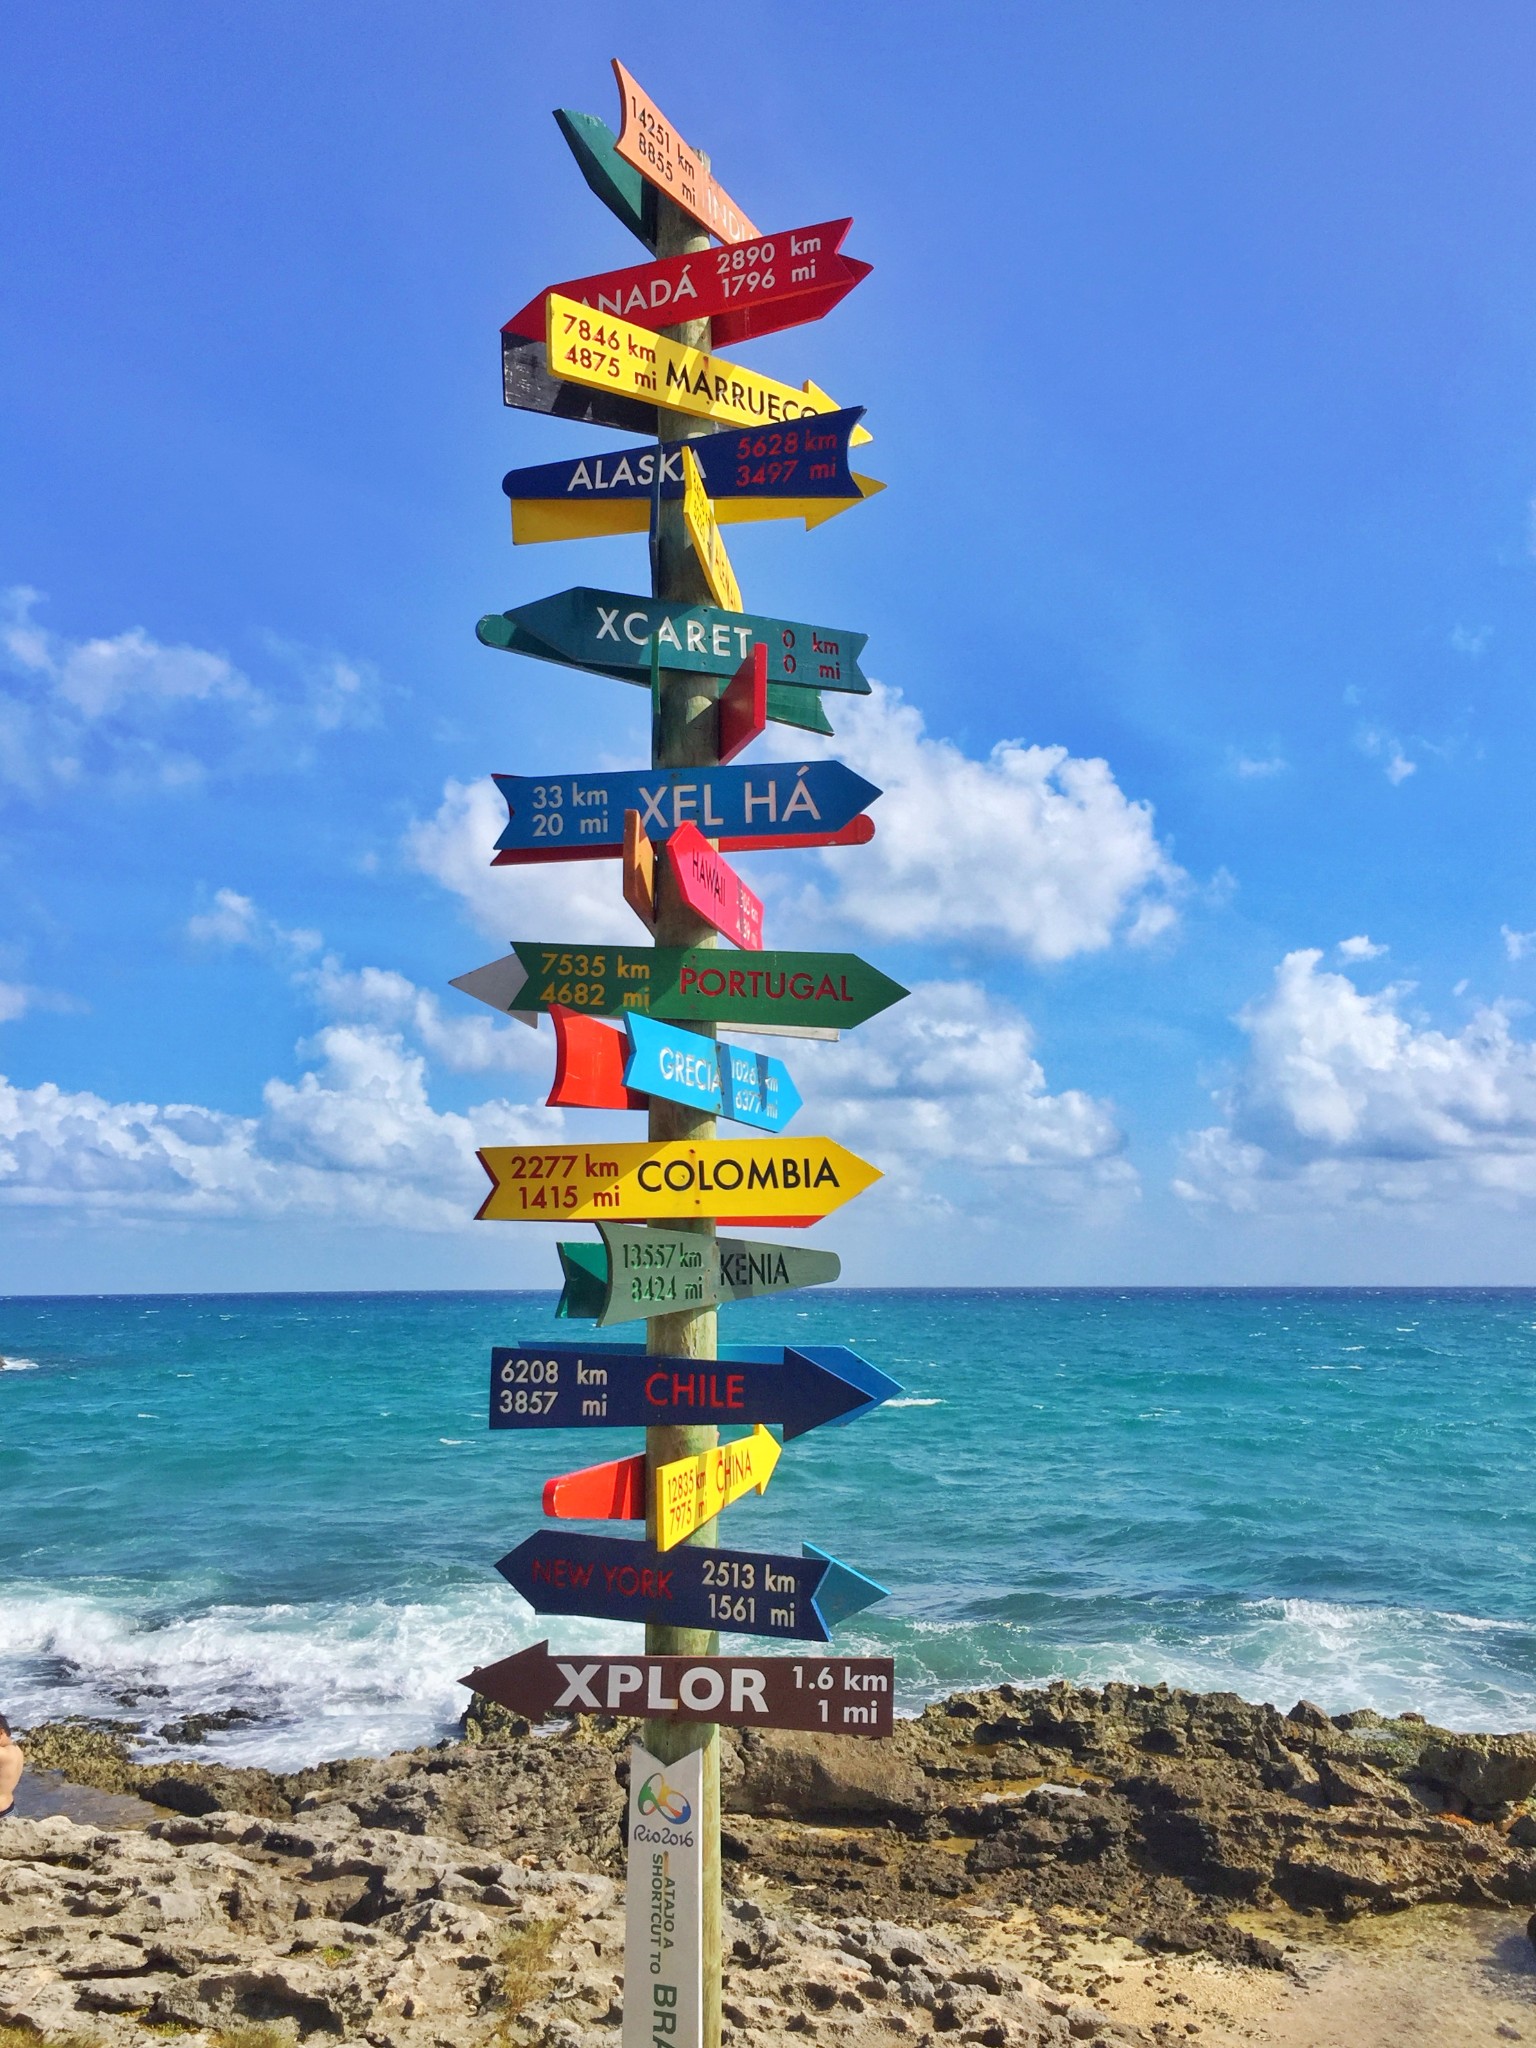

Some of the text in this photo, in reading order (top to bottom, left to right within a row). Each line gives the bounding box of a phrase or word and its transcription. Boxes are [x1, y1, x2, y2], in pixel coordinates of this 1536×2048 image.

[632, 96, 695, 180] 14251 km
[638, 132, 696, 207] 8855 mi
[707, 188, 753, 240] INDI
[717, 236, 821, 275] 2890 km
[721, 259, 816, 298] 1796 mi
[563, 313, 657, 365] 7846 km
[564, 344, 657, 391] 4875 mi
[736, 428, 837, 460] 5628 km
[567, 449, 707, 492] ALASKA
[736, 456, 836, 488] 3497 mi
[596, 607, 753, 659] XCARET
[782, 629, 839, 655] 0 km
[783, 654, 841, 680] 0 mi
[532, 782, 608, 809] 33 km
[638, 766, 821, 828] XEL HÁ
[532, 811, 608, 837] 20 mi
[692, 848, 726, 907] HAWAII
[541, 953, 650, 979] 7535 km
[539, 982, 650, 1010] 4682 mi
[680, 967, 854, 1002] PORTUGAL
[659, 1047, 722, 1094] GRECIA
[735, 1089, 763, 1114] 6377
[511, 1153, 619, 1179] 2277 km
[637, 1157, 840, 1192] COLOMBIA
[518, 1184, 620, 1209] 1415 mi
[622, 1242, 702, 1269] 13557 km
[720, 1252, 790, 1286] KENIA
[631, 1275, 703, 1302] 8424 mi
[501, 1360, 608, 1385] 6208 km
[644, 1371, 745, 1409] CHILE
[499, 1389, 607, 1416] 3857 mi
[667, 1468, 694, 1505] 12835
[716, 1448, 752, 1494] CHINA
[670, 1500, 692, 1535] 7975
[531, 1558, 674, 1600] NEW YORK
[702, 1560, 796, 1594] 2513 km
[708, 1593, 795, 1628] 1561 mi
[553, 1663, 770, 1713] XPLOR
[792, 1665, 888, 1692] 1.6 km
[818, 1699, 878, 1723] 1 mi
[649, 1853, 664, 1974] SHORTCUT TO
[663, 1876, 676, 1949] ATAJO A
